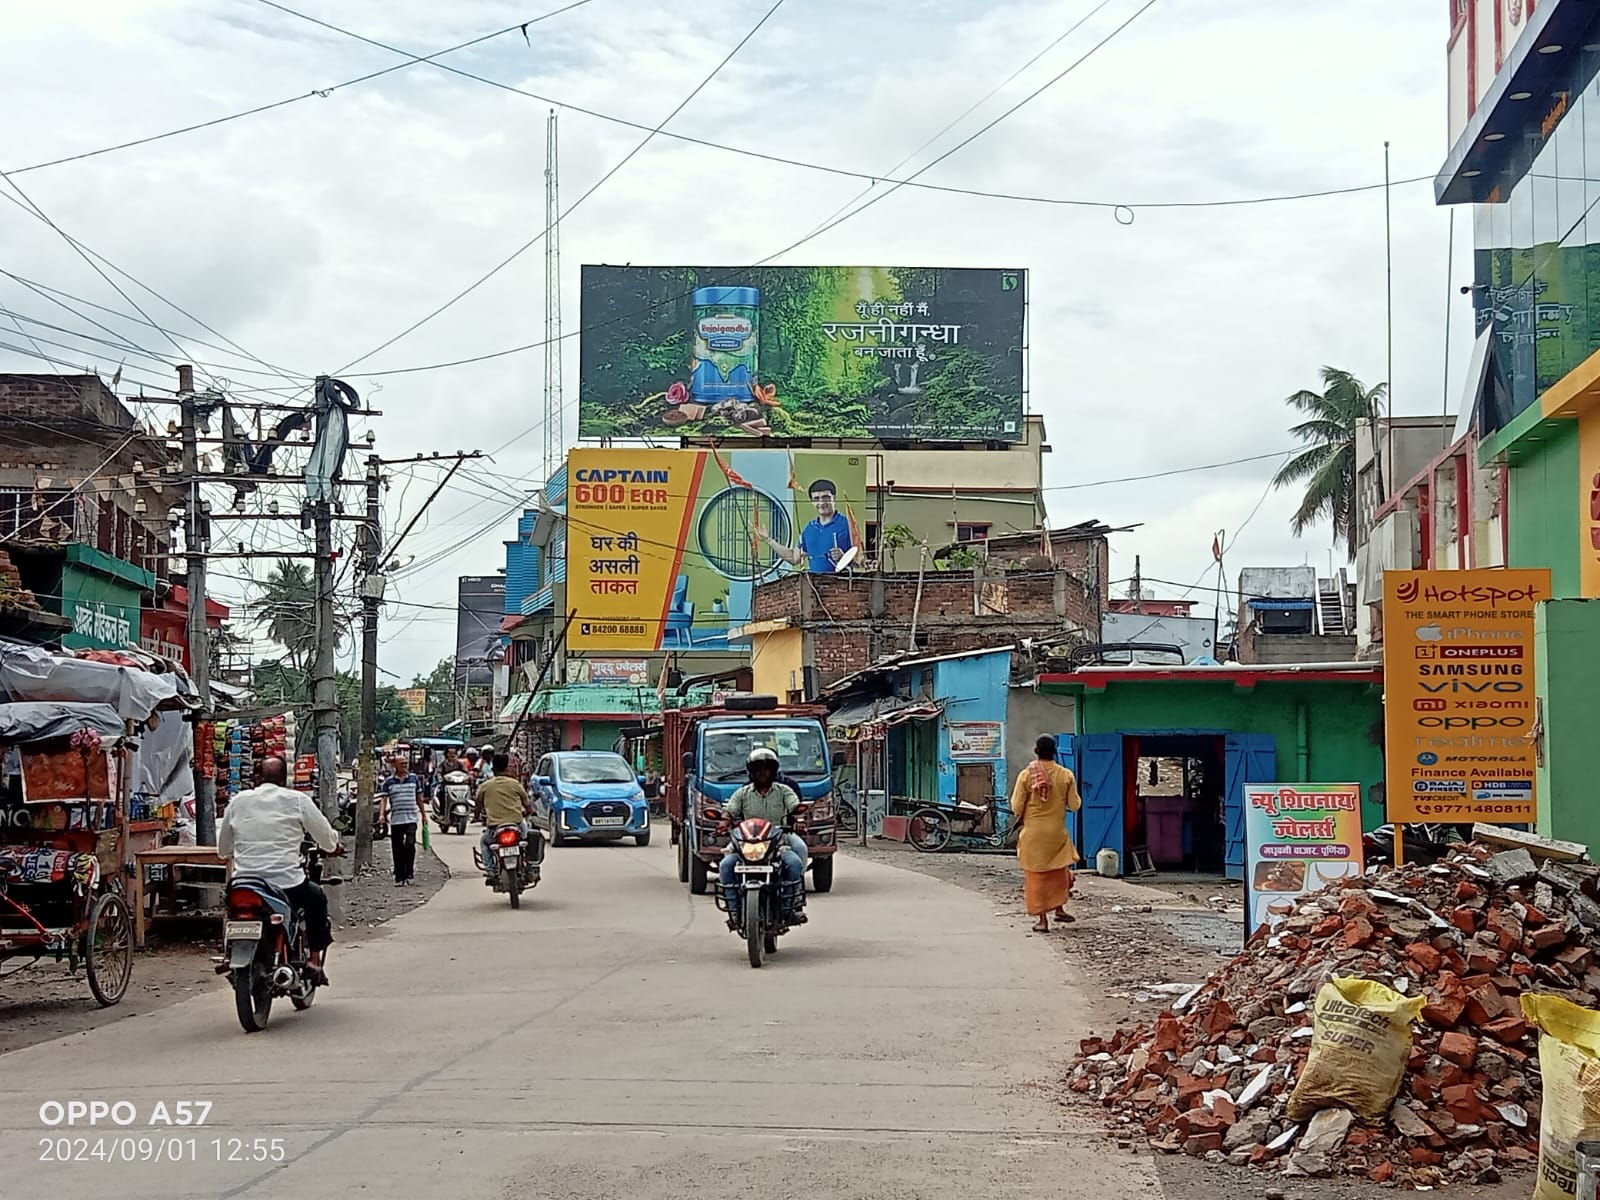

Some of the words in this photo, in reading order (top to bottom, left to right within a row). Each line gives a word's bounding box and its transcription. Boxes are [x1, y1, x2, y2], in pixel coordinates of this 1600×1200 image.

[870, 303, 884, 316] ही
[888, 302, 914, 317] नहीं
[701, 324, 749, 335] Rajnigandha
[822, 317, 961, 344] रजनीगन्धा
[854, 346, 874, 358] बन
[878, 346, 913, 358] जाता
[576, 469, 668, 483] CAPTAIN
[575, 484, 625, 503] 600
[630, 489, 668, 504] EQR
[590, 535, 613, 552] घर
[616, 532, 639, 552] की
[589, 557, 640, 575] असली
[590, 580, 639, 595] ताकत
[1405, 610, 1424, 619] THE
[1426, 610, 1461, 619] SMART
[1463, 610, 1498, 620] PHONE
[1500, 610, 1532, 619] STORE
[1446, 626, 1523, 640] iPhone
[1444, 647, 1519, 657] ONEPLUS
[1419, 664, 1523, 676] SAMSUNG
[1418, 679, 1523, 693] vivo
[1414, 735, 1529, 749] realme
[1411, 768, 1466, 777] Finance
[1469, 768, 1534, 777] Available
[1250, 792, 1277, 815] न्यू
[1433, 805, 1531, 814] 9771480811
[1271, 817, 1336, 839] ज्वेलर्स
[1322, 999, 1392, 1029] UltraTech
[1321, 1030, 1375, 1055] SUPER
